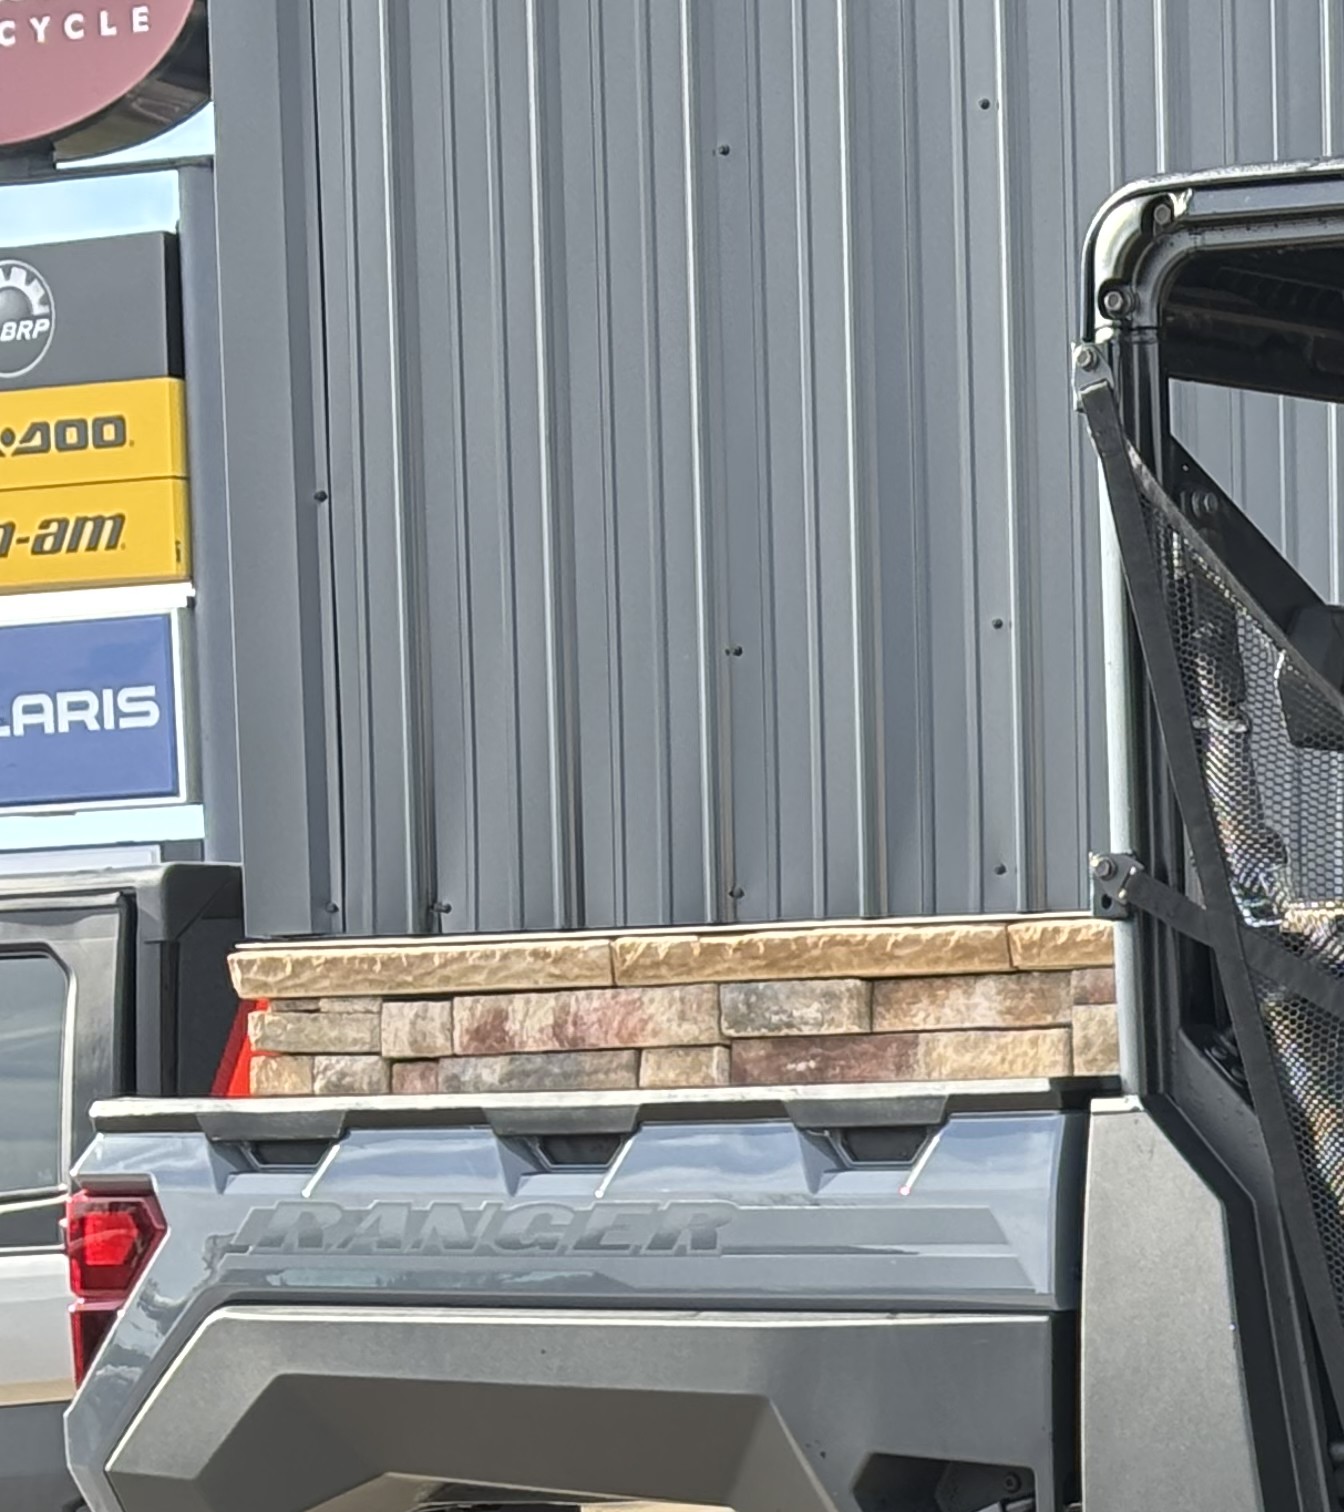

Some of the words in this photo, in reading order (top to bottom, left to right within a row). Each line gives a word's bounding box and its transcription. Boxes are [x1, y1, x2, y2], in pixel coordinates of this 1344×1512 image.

[0, 5, 150, 47] CYCLE
[0, 318, 51, 342] BRP
[252, 1200, 736, 1256] RANGER
